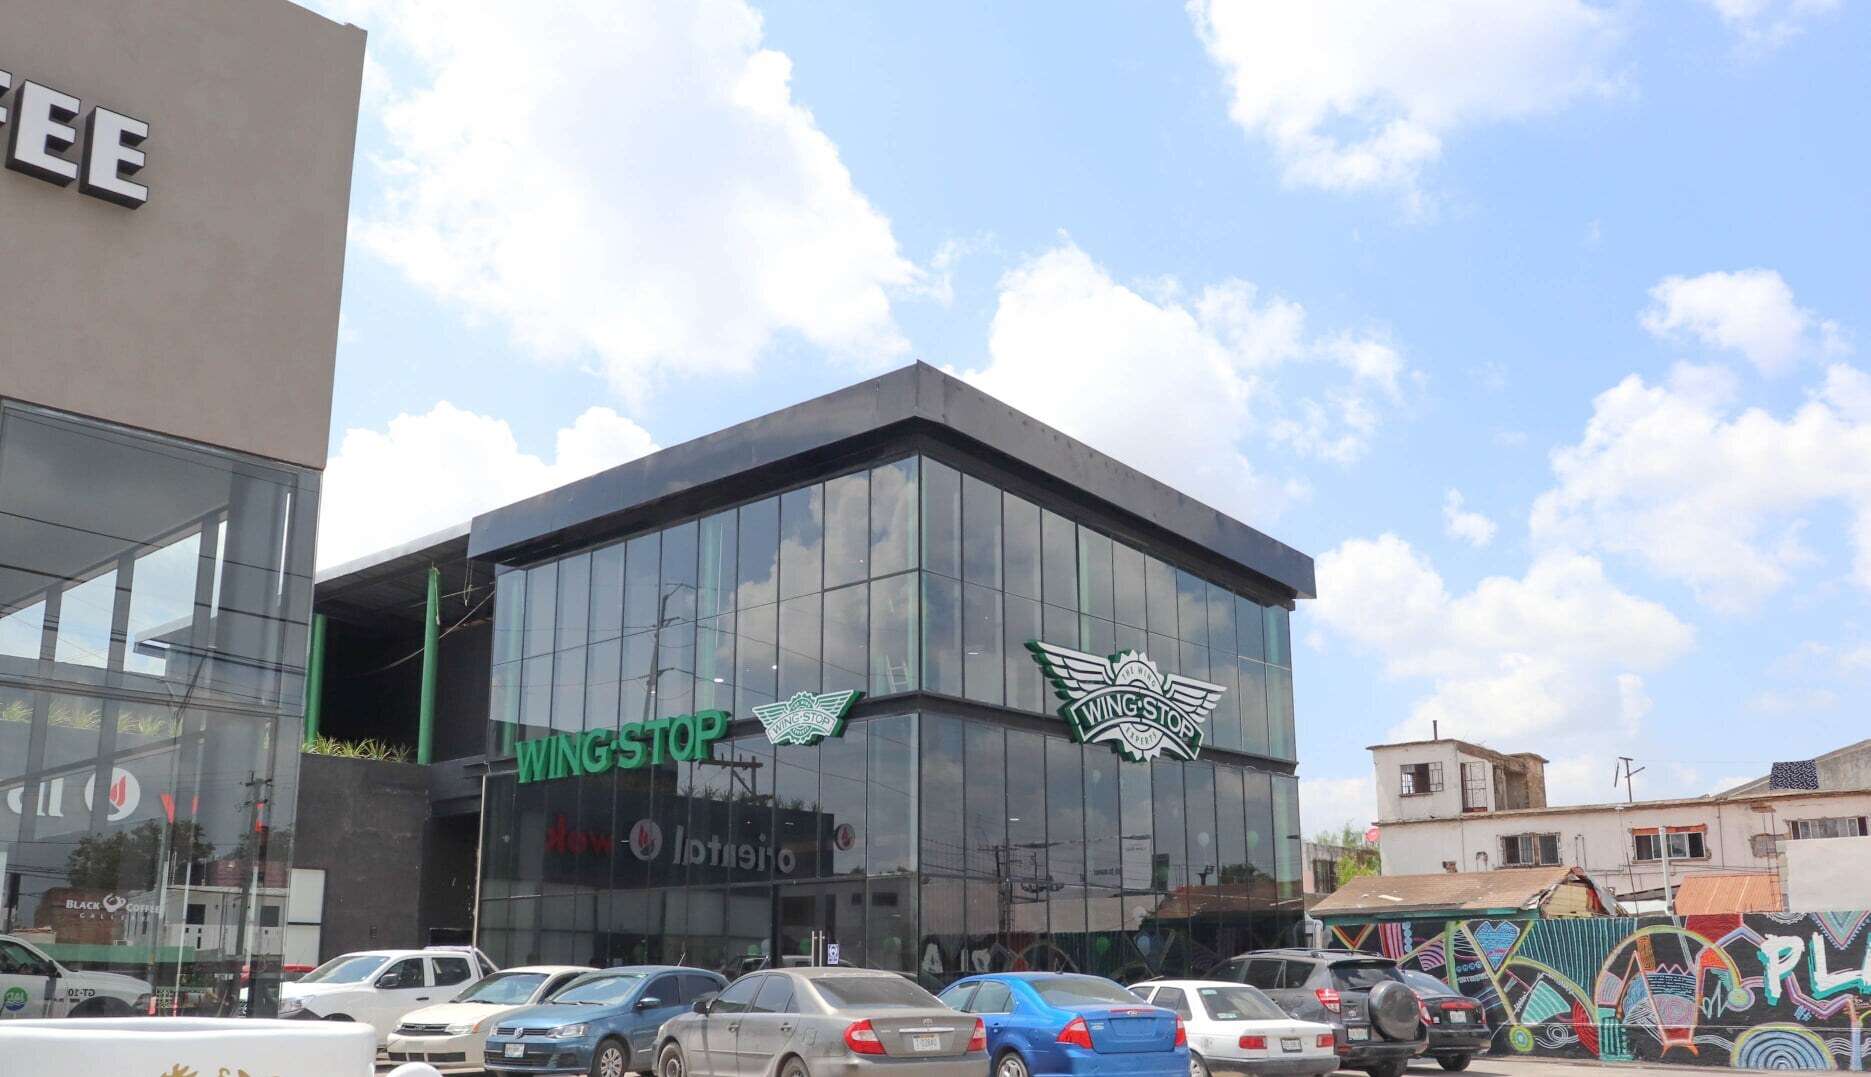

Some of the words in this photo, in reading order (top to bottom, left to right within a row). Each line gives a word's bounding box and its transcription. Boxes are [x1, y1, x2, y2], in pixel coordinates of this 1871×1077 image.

[0, 69, 149, 210] EE
[1122, 664, 1134, 681] THE
[1137, 665, 1157, 688] WING
[1125, 726, 1158, 746] EXPERTS
